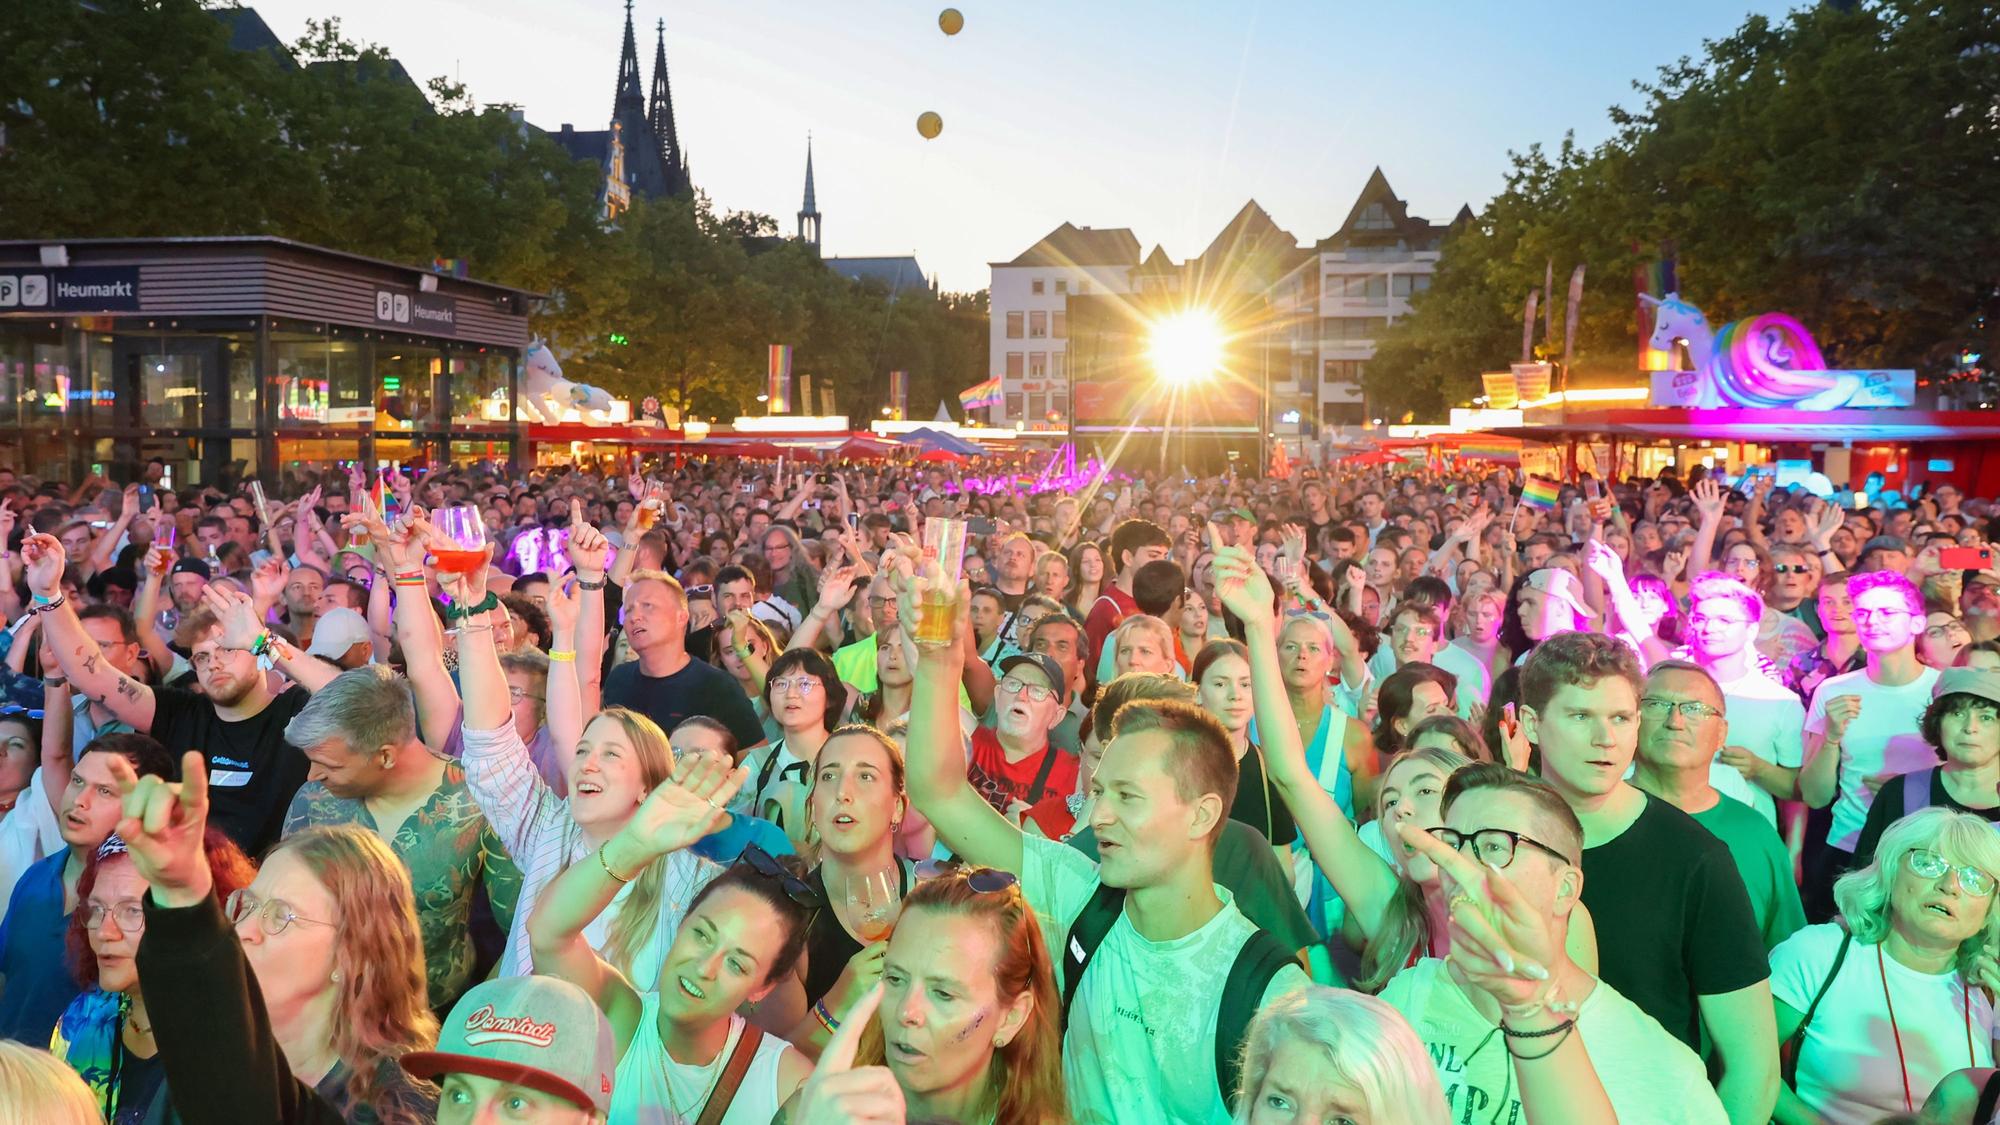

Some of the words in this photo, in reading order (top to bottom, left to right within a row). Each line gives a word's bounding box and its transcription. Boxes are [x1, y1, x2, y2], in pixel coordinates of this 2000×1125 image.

[57, 281, 132, 297] Heumarkt
[414, 305, 453, 323] Heumarkt
[465, 1004, 556, 1039] Domstadt
